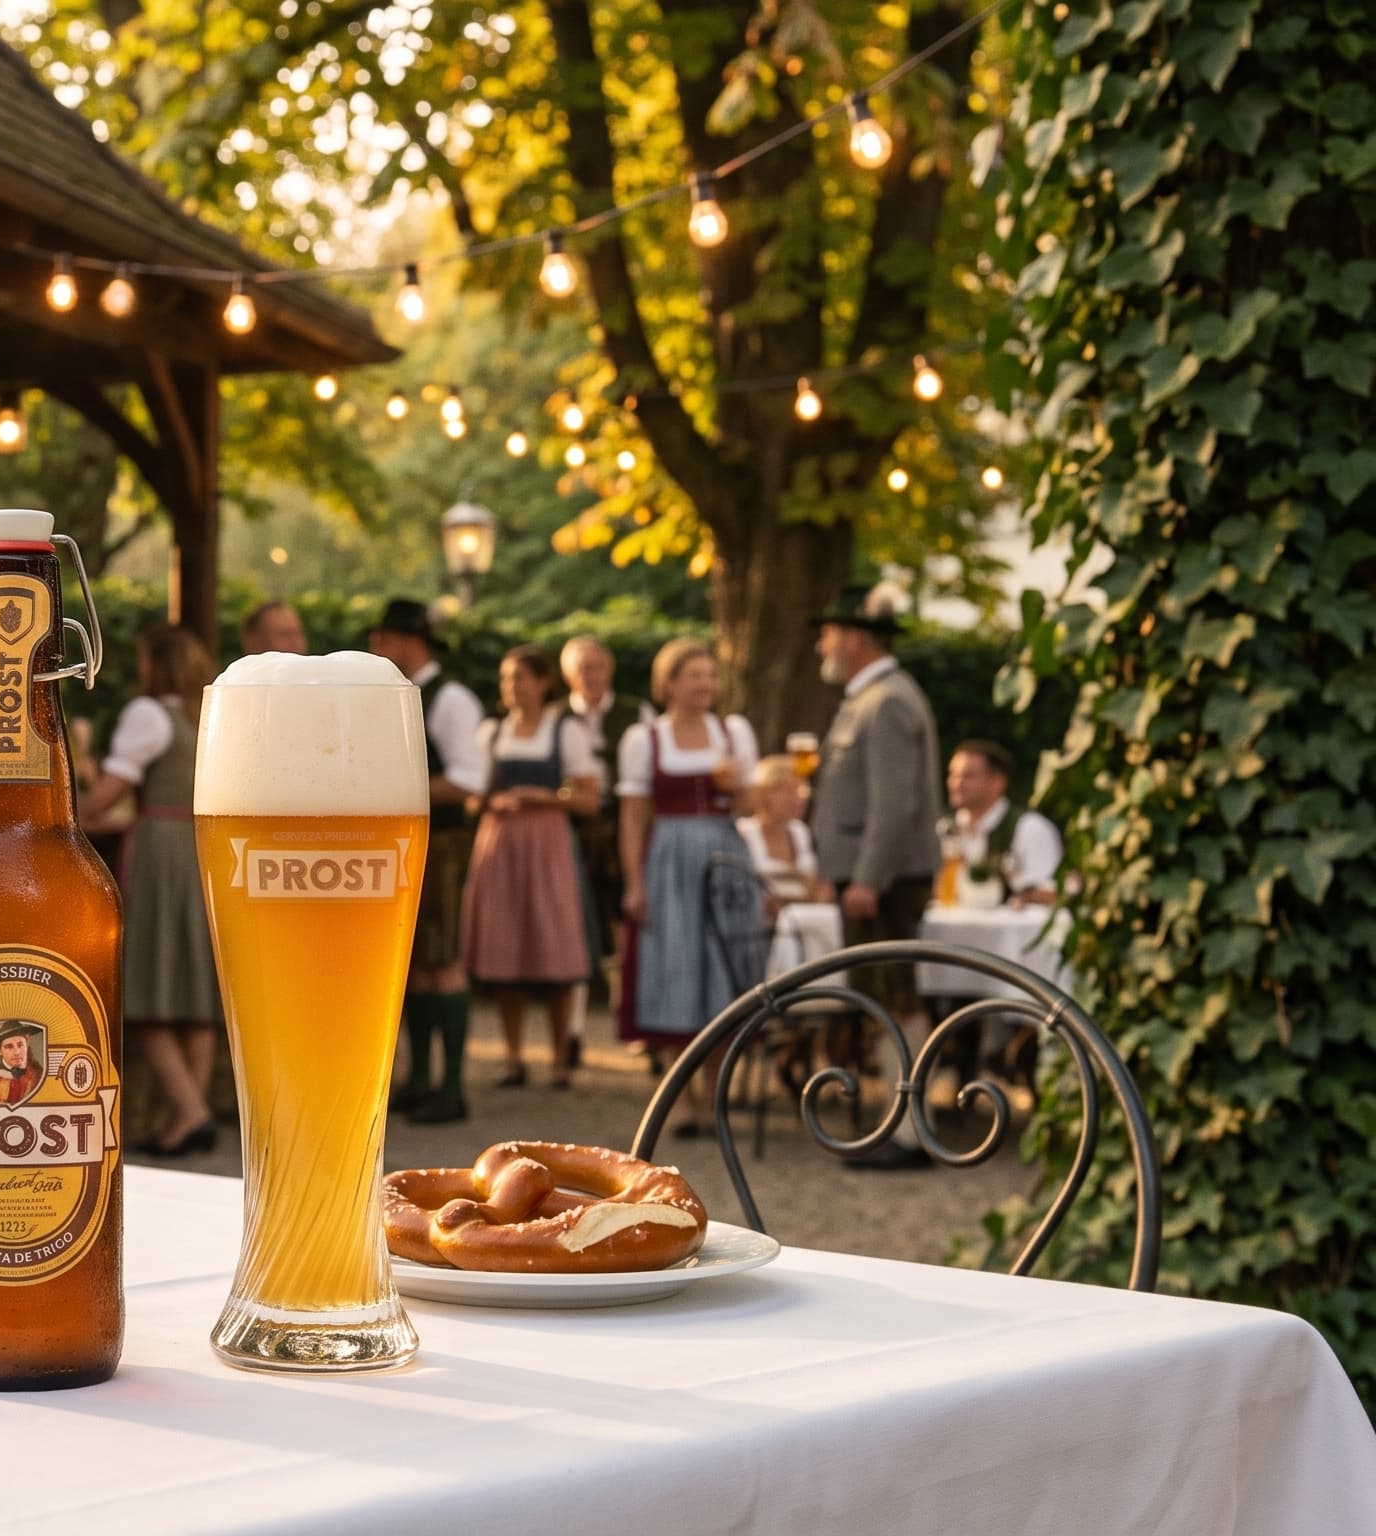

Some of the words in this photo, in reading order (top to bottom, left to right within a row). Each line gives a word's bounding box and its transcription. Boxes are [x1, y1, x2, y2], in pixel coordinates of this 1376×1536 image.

[257, 858, 389, 892] PROST
[0, 1221, 26, 1233] 1223
[14, 1253, 33, 1263] DE
